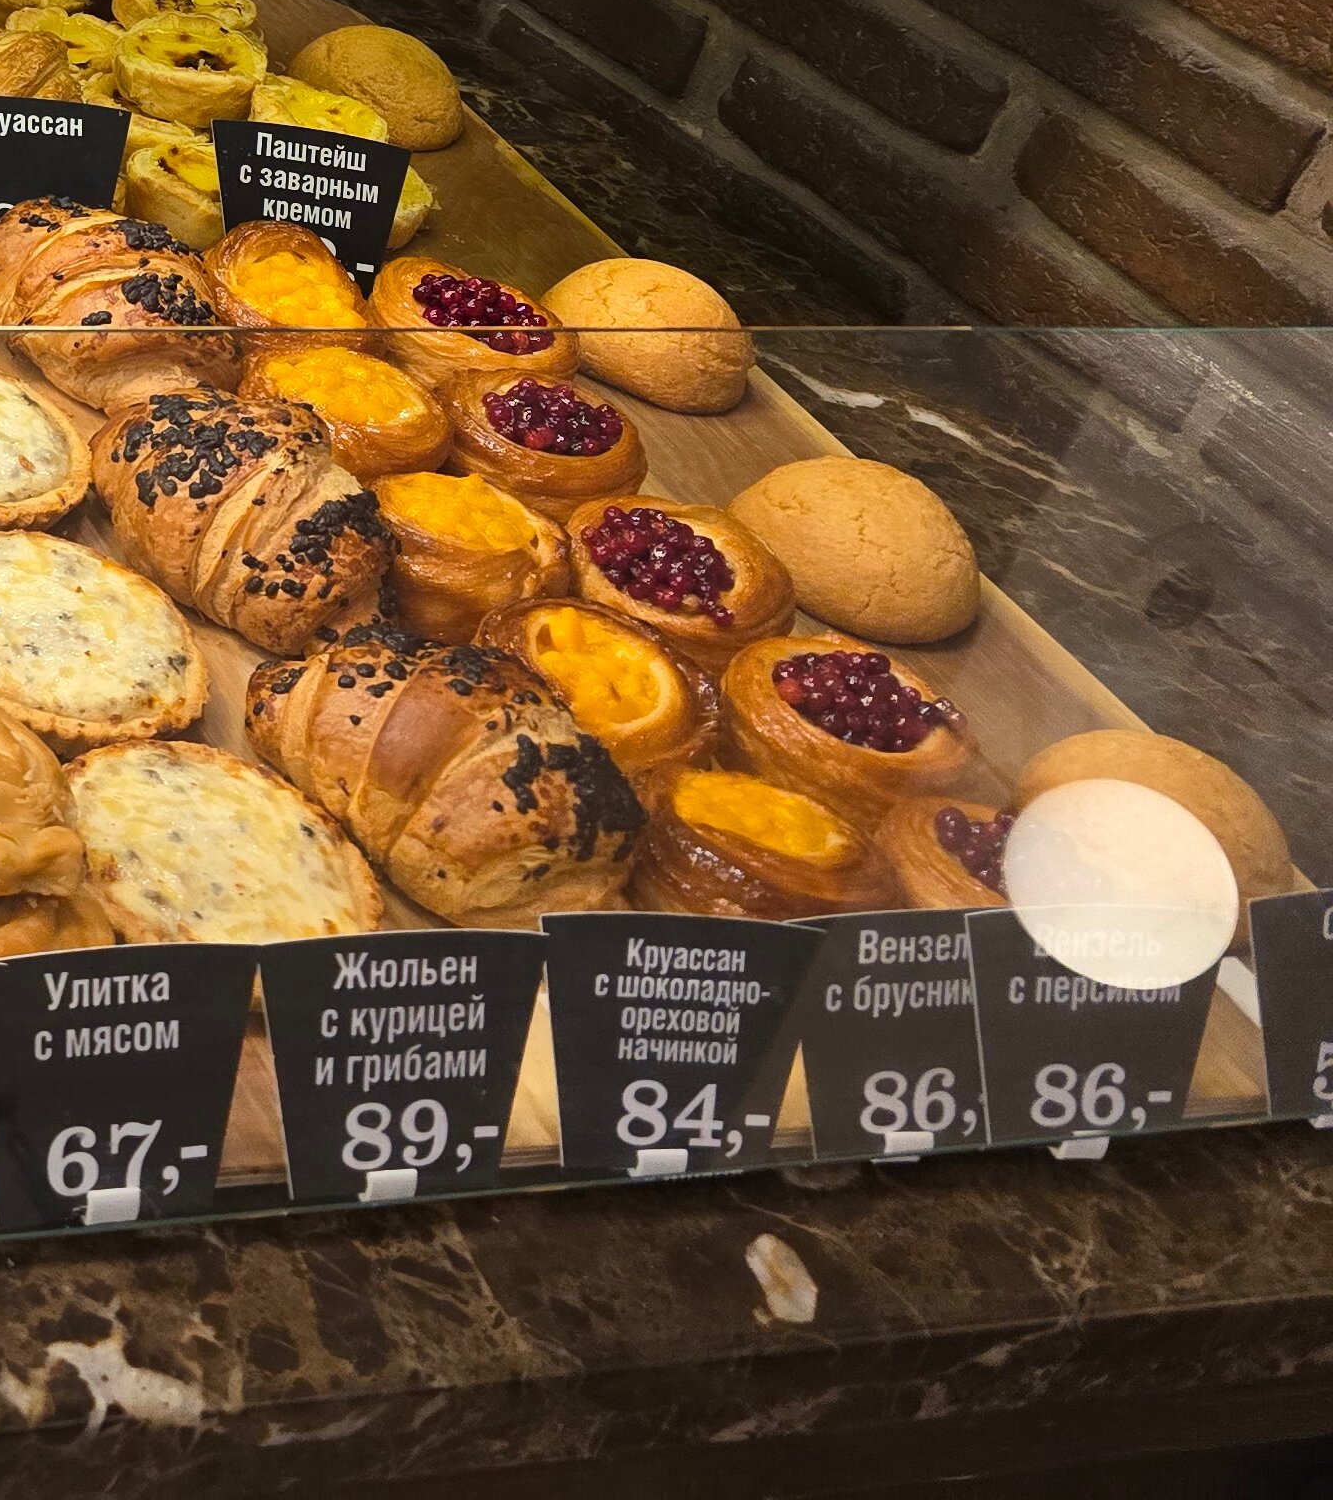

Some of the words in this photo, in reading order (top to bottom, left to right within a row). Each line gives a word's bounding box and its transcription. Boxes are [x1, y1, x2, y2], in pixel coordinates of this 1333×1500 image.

[256, 132, 366, 171] Паштейш
[239, 165, 252, 183] с
[259, 167, 379, 204] заварным
[263, 198, 352, 229] кремом
[626, 937, 746, 974] Круассан
[858, 929, 969, 964] Вензел
[333, 952, 478, 990] Жюльен
[594, 974, 610, 997] с
[616, 976, 771, 1006] шоколадно-
[1008, 975, 1025, 1003] с
[43, 972, 170, 1011] Улитка
[826, 983, 842, 1012] с
[853, 975, 975, 1018] брусник
[321, 1008, 338, 1038] с
[350, 994, 486, 1044] курицей
[621, 1006, 741, 1035] ореховой
[34, 1031, 53, 1061] с
[65, 1020, 180, 1058] мясом
[618, 1036, 737, 1064] начинкой
[315, 1057, 334, 1086] и
[346, 1043, 486, 1092] грибами
[859, 1067, 983, 1137] 86,
[1030, 1063, 1172, 1130] 86,-
[341, 1099, 499, 1173] 89,-
[616, 1079, 771, 1158] 84,-
[46, 1119, 208, 1197] 67,-
